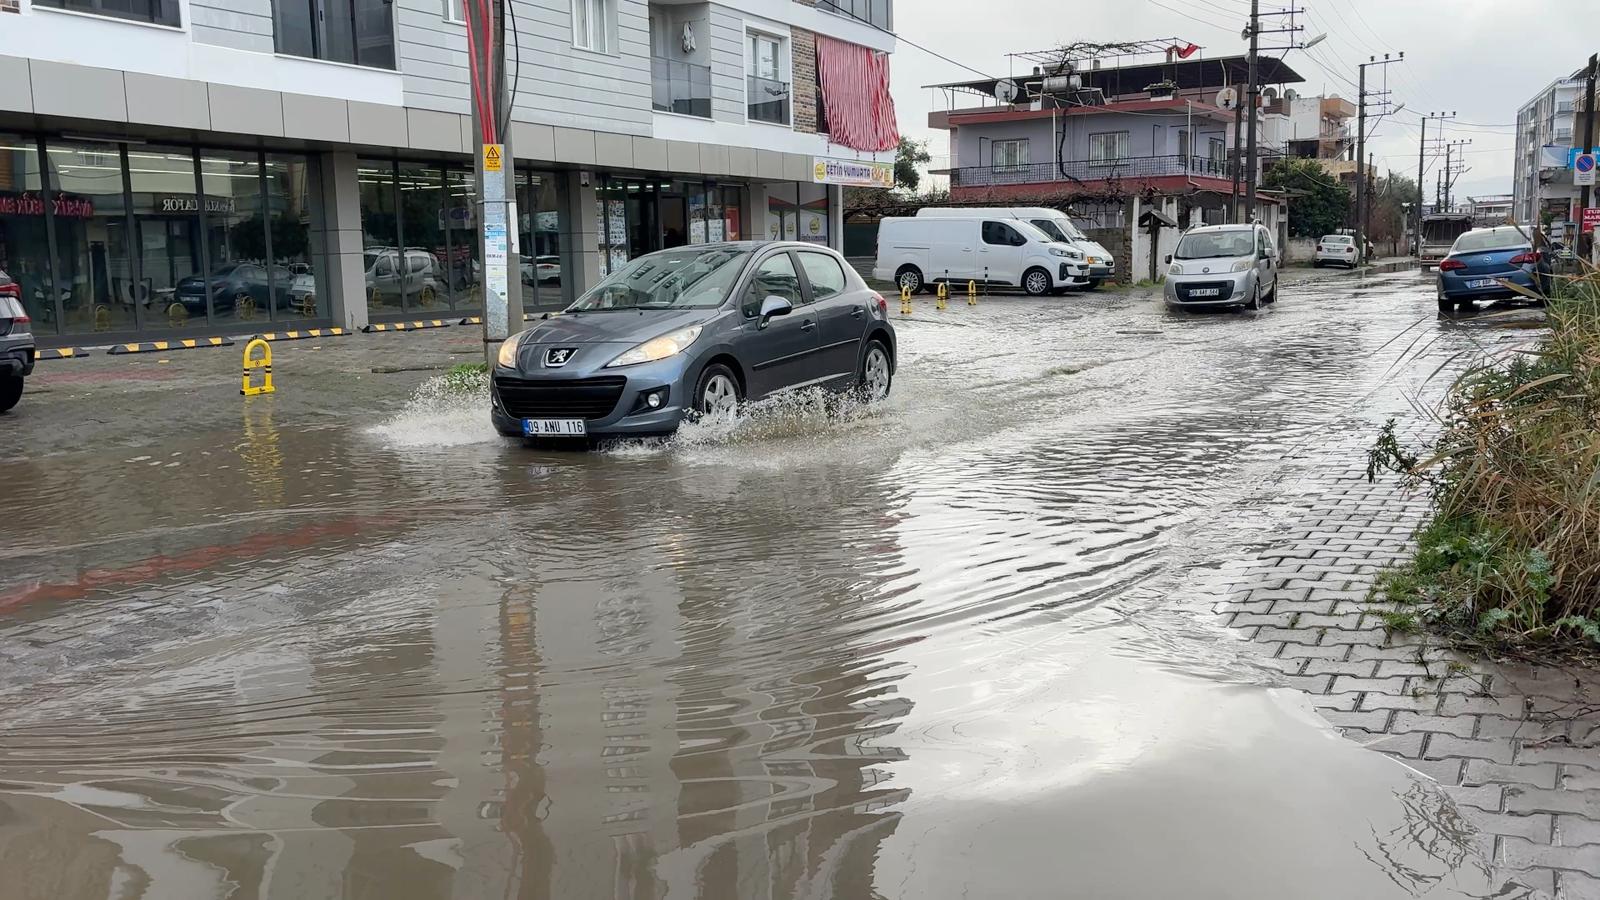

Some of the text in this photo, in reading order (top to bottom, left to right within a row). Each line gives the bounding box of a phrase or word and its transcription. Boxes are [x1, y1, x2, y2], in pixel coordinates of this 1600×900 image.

[528, 421, 583, 432] 09 ANU 116
